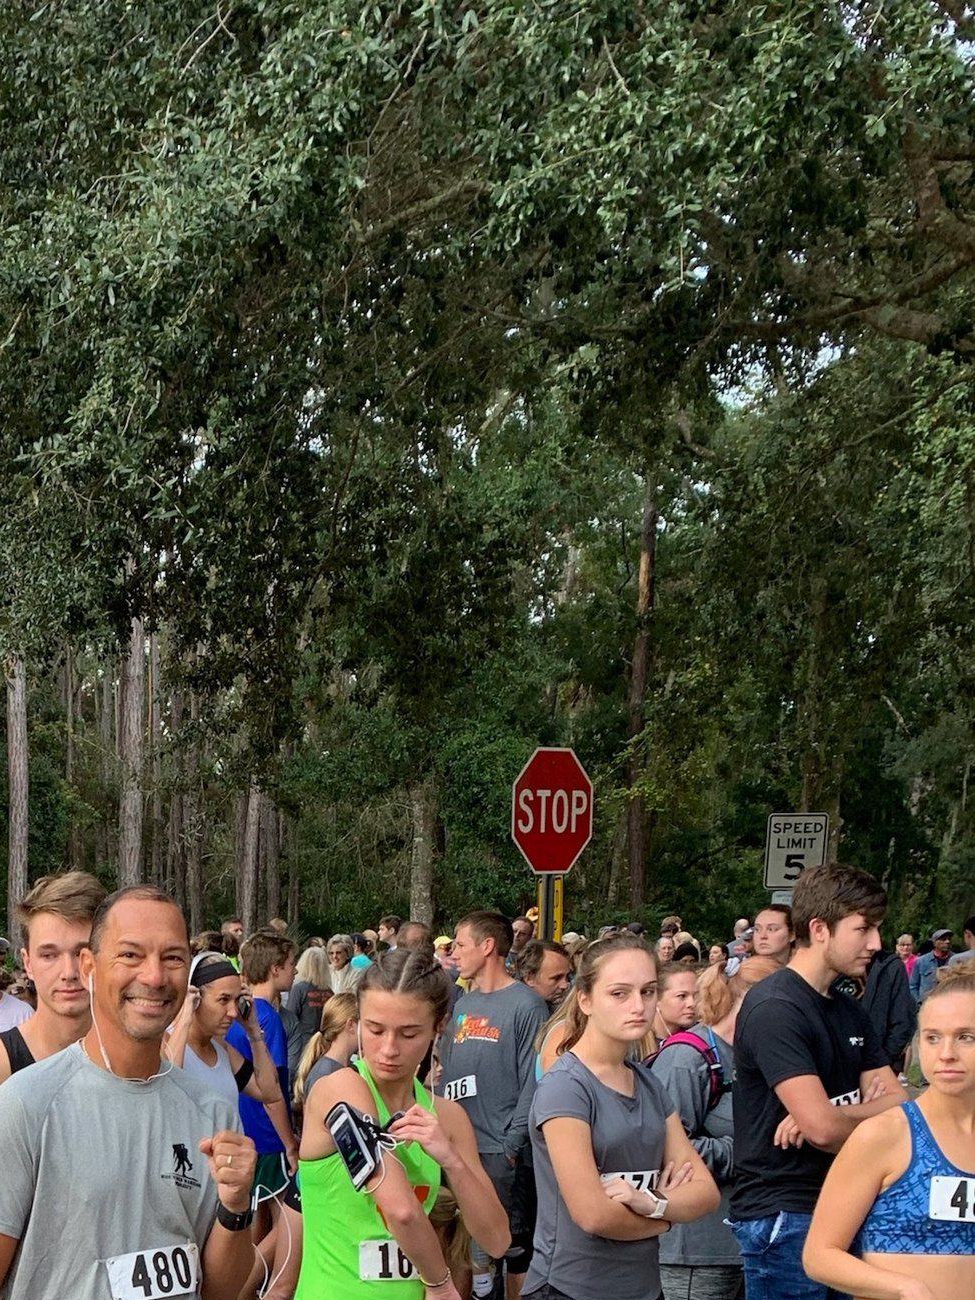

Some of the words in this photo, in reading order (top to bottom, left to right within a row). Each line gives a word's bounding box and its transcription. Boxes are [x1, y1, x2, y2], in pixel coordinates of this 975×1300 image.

[517, 788, 588, 834] STOP
[772, 822, 824, 834] SPEED
[776, 837, 817, 849] LIMIT
[783, 853, 805, 880] 5
[447, 1079, 467, 1100] 316
[950, 1180, 975, 1218] 4
[131, 1246, 192, 1297] 480
